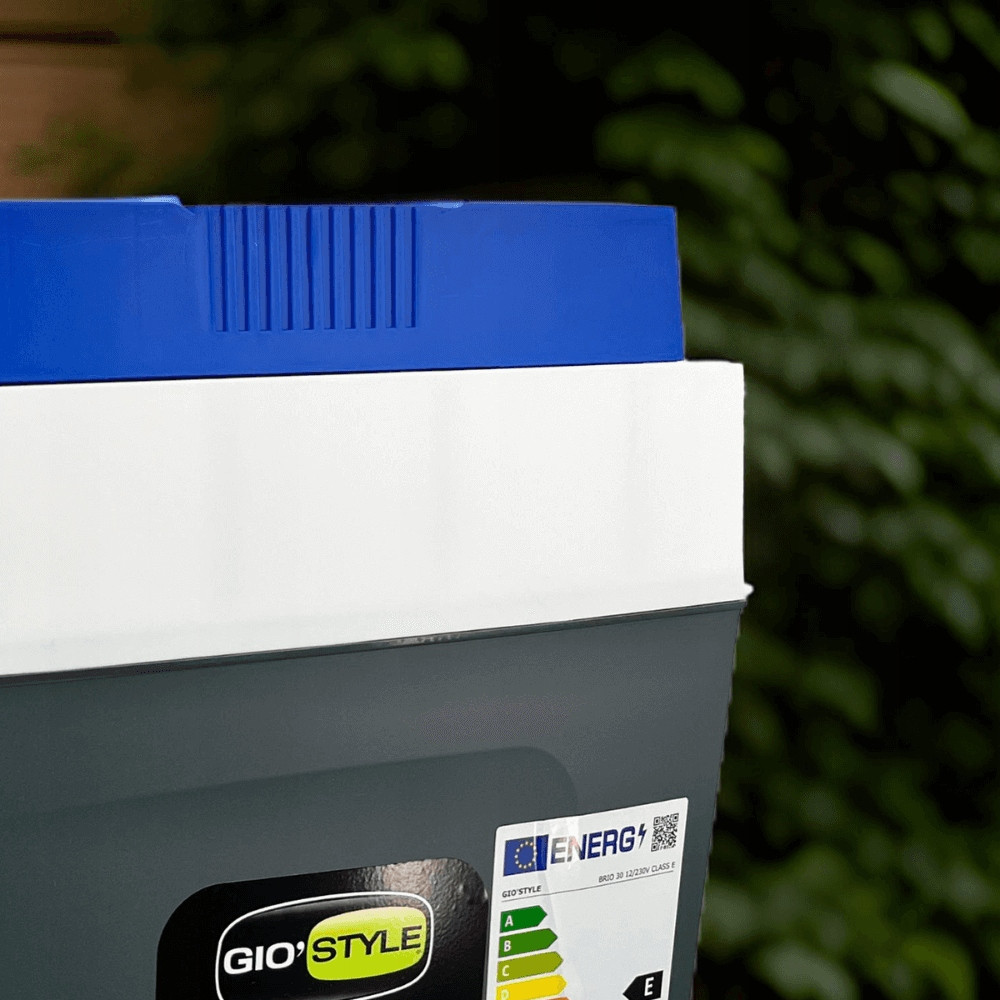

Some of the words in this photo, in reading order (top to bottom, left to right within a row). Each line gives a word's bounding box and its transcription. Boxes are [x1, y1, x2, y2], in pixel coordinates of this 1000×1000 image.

[550, 826, 635, 864] ENERG
[599, 873, 615, 883] BRIO
[616, 871, 624, 880] 30
[625, 866, 650, 879] 12/230V
[651, 863, 670, 874] CLASS
[502, 885, 541, 898] GIO'STYLE
[504, 915, 514, 927] A
[503, 940, 511, 952] B
[502, 966, 510, 977] C
[644, 977, 654, 996] E
[500, 990, 510, 1000] D
